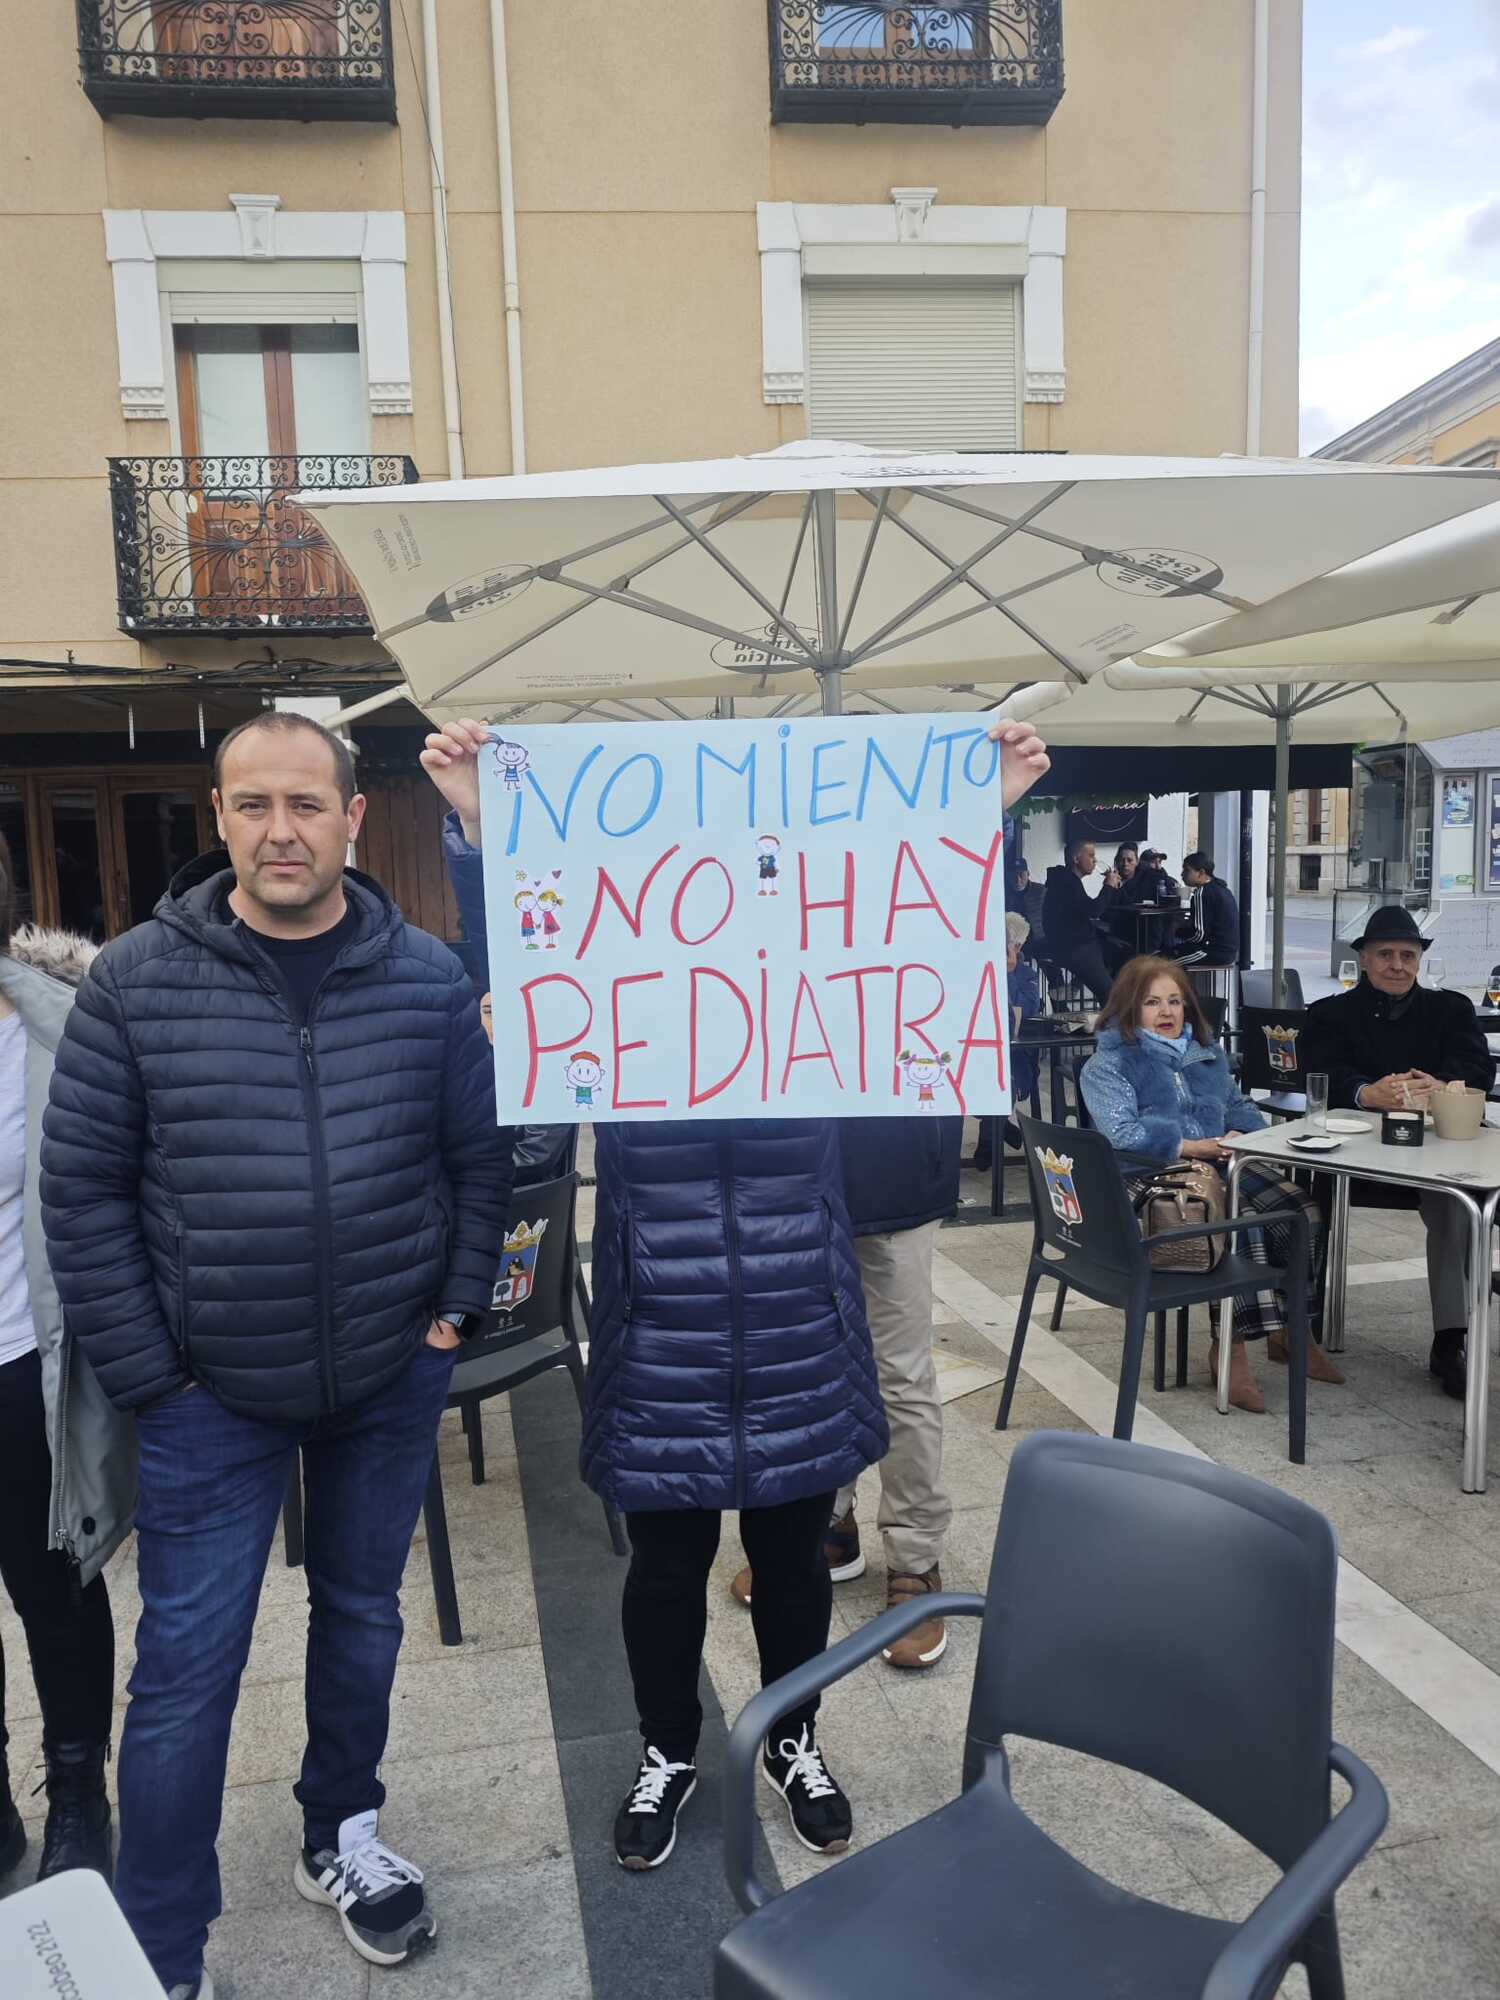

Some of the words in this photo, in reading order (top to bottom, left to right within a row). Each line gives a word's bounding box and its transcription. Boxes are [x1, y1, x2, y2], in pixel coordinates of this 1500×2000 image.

[505, 744, 664, 856] NO
[575, 844, 735, 960] NO
[798, 830, 1003, 951] HAY
